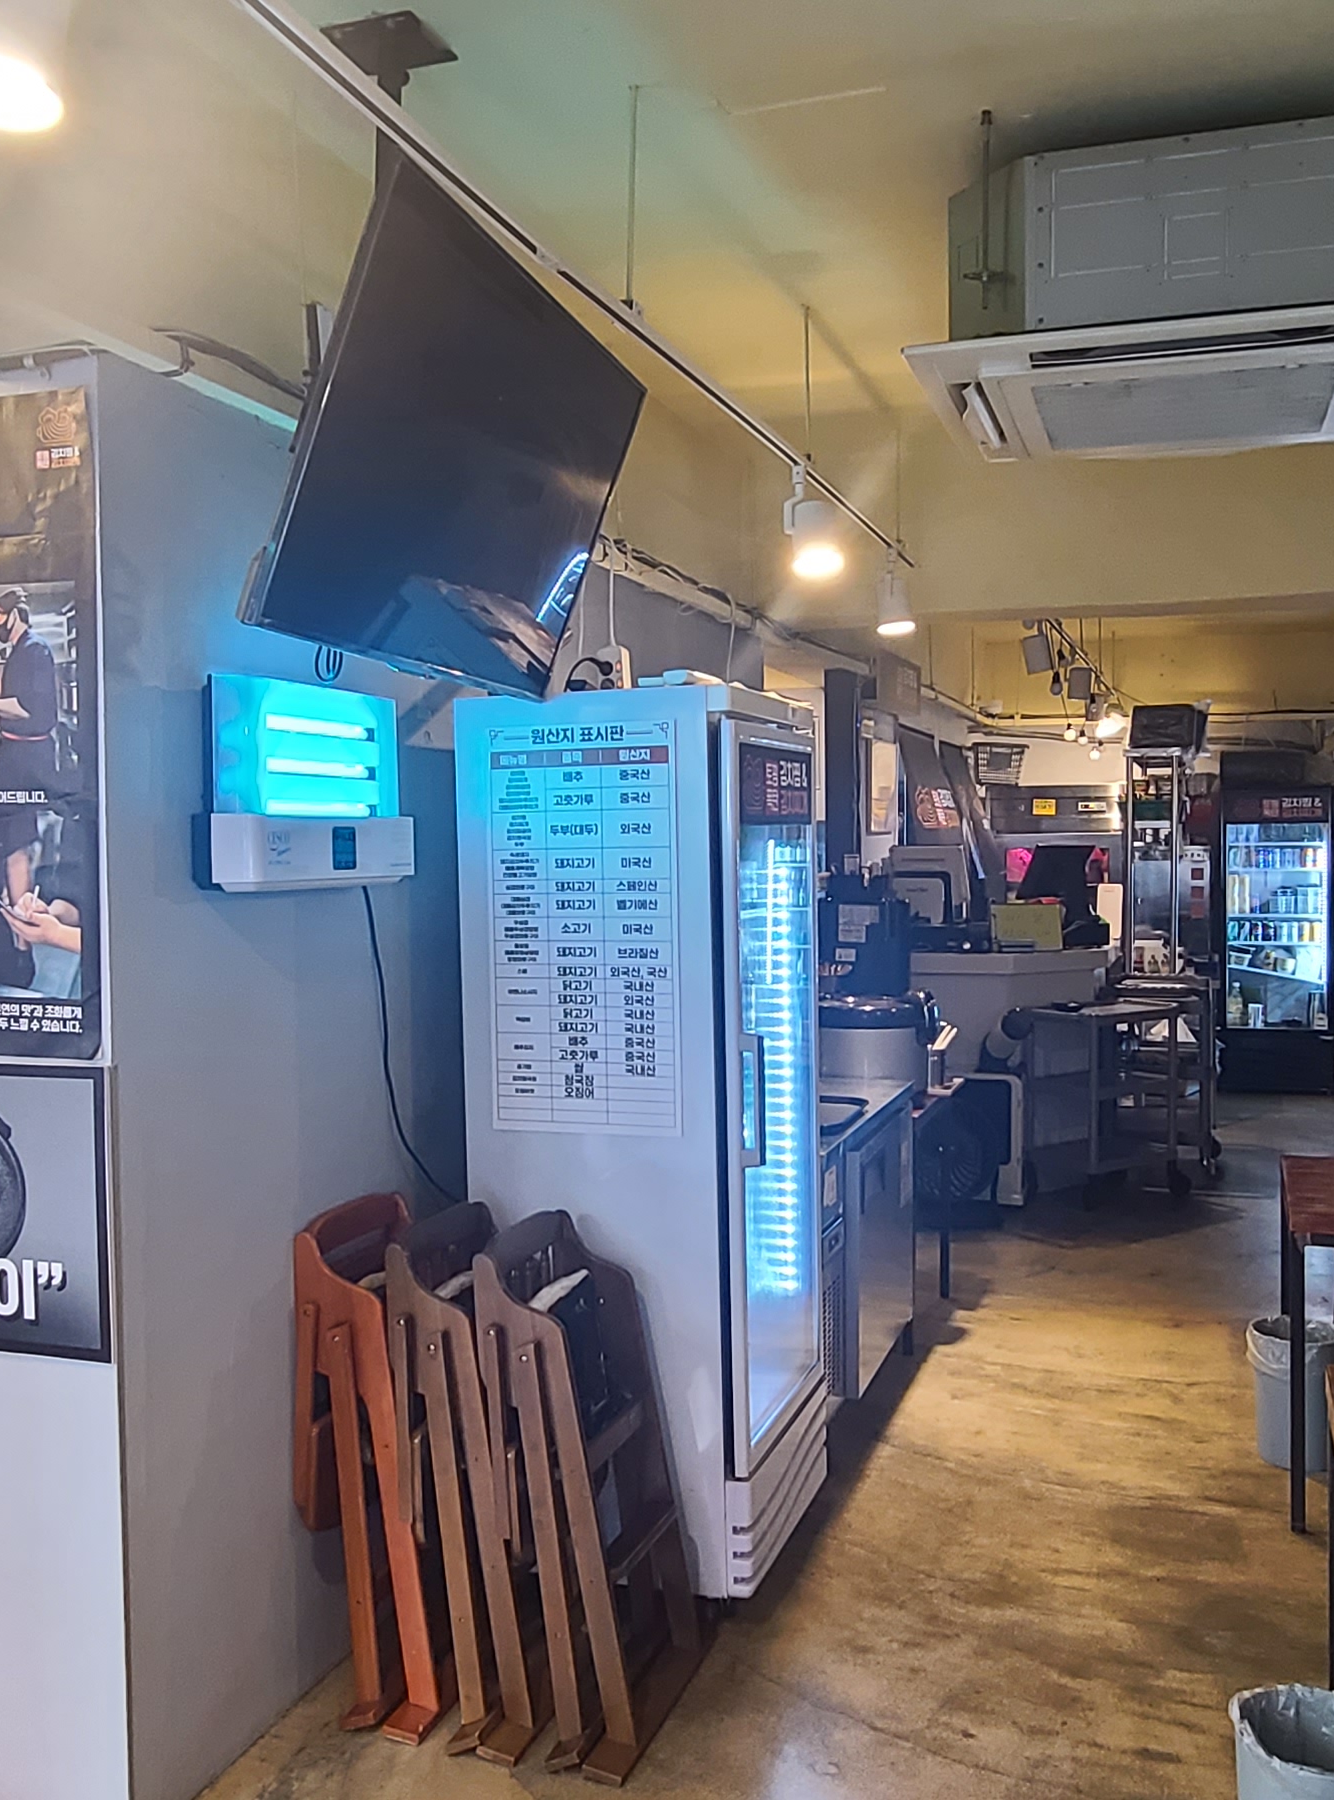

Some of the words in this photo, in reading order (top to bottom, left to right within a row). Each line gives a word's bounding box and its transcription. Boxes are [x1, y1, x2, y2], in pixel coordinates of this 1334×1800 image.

[531, 727, 574, 744] 원산지
[579, 725, 623, 742] 표시판
[619, 749, 650, 761] 원산지
[619, 770, 651, 780] 중국산
[619, 792, 651, 804] 중국산
[549, 823, 598, 836] 두부(대두)
[620, 822, 651, 834] 외국산
[555, 857, 595, 868] 돼지고기
[621, 857, 651, 868] 미국산
[555, 881, 595, 892] 돼지고기
[615, 880, 657, 892] 스페인산
[555, 899, 595, 910] 돼지고기
[617, 899, 657, 910] 벨기에산
[561, 922, 591, 934] 소고기
[623, 924, 653, 935] 미국산
[557, 946, 597, 958] 돼지고기
[617, 948, 659, 959] 브라질산
[557, 966, 597, 978] 돼지고기
[610, 966, 643, 980] 외국산,
[647, 966, 667, 978] 국산
[563, 980, 592, 992] 닭고기
[623, 980, 655, 992] 국내산
[557, 994, 597, 1006] 돼지고기
[623, 994, 655, 1006] 외국산
[563, 1008, 593, 1019] 닭고기
[624, 1008, 655, 1020] 국내산
[30, 1019, 40, 1032] 수
[41, 1019, 83, 1034] 있습니다.
[558, 1022, 598, 1034] 돼지고기
[625, 1023, 655, 1035] 국내산
[625, 1037, 655, 1049] 중국산
[625, 1051, 655, 1063] 중국산
[625, 1064, 656, 1077] 국내산
[564, 1086, 595, 1099] 오징어
